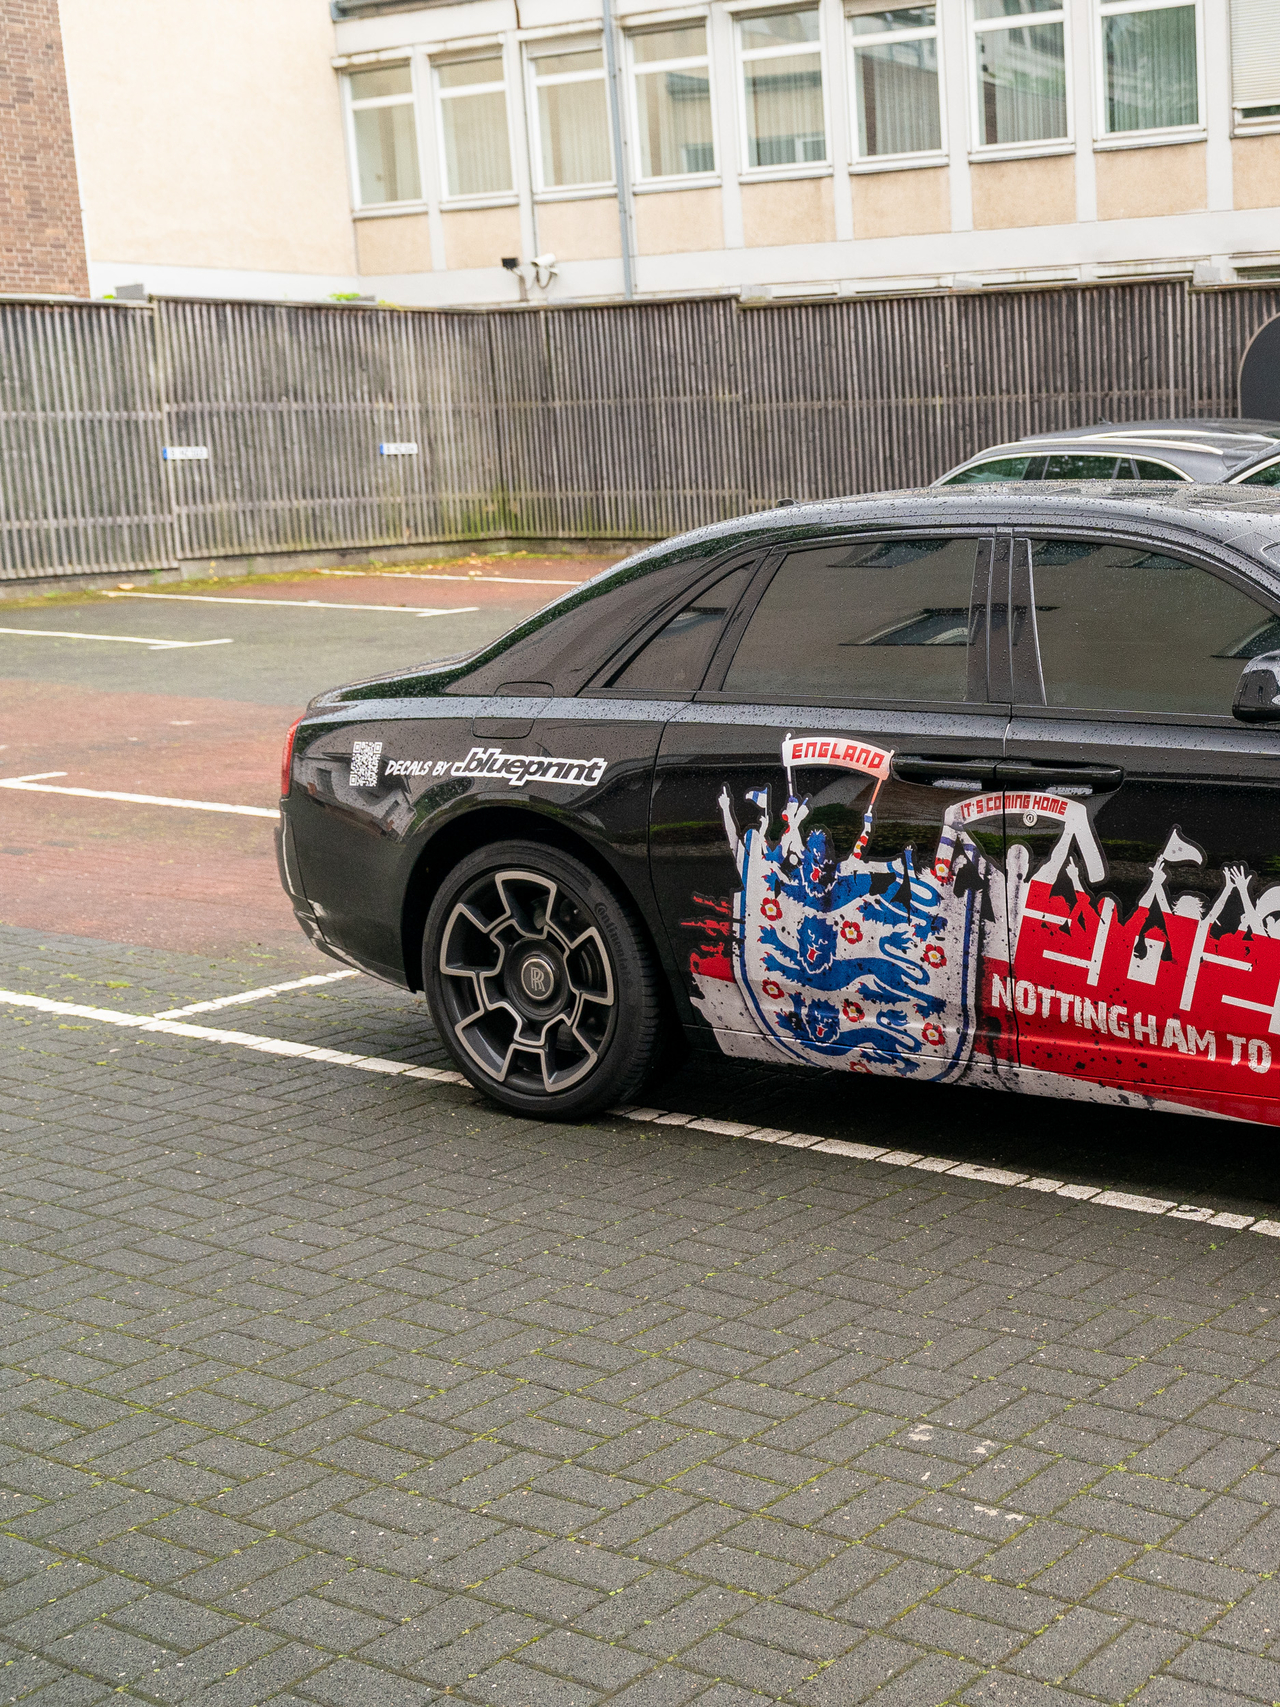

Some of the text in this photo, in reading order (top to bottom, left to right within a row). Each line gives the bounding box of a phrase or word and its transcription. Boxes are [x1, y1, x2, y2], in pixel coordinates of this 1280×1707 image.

[791, 742, 885, 768] ENGLAND
[384, 760, 433, 776] DECALS
[431, 761, 452, 776] BY
[960, 794, 1069, 818] IT'S COMING HOME
[991, 972, 1217, 1062] NOTTINGHAM
[1226, 1032, 1272, 1074] TO
